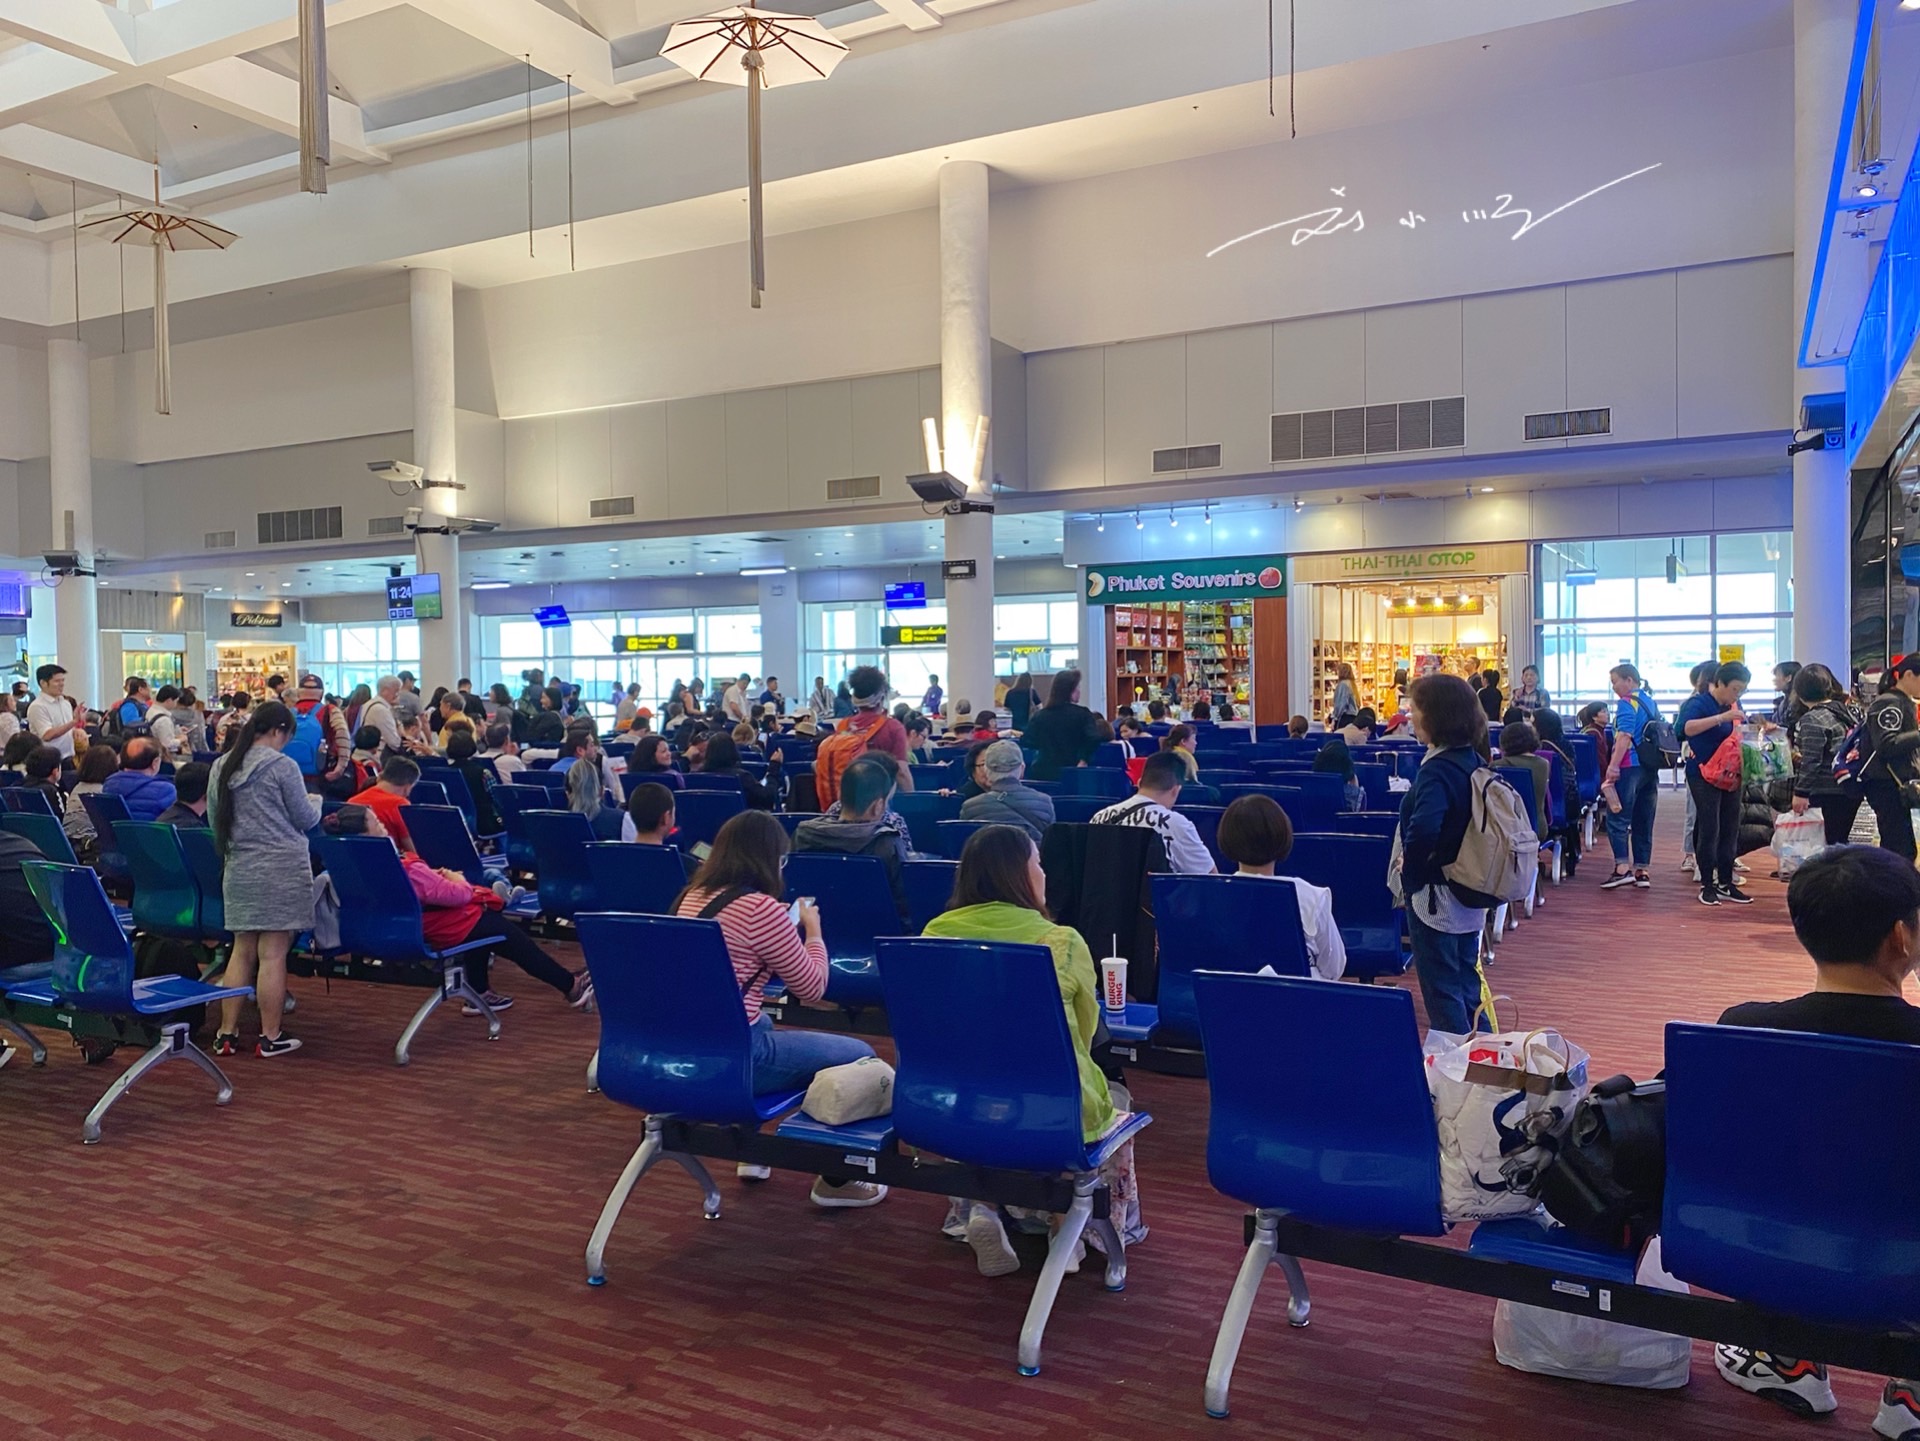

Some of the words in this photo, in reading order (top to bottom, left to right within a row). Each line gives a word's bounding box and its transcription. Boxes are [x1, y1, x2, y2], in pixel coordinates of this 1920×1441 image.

[1341, 554, 1423, 570] THAI-THAI
[1428, 551, 1476, 566] OTOP
[1107, 574, 1165, 593] Phuket
[1171, 570, 1257, 589] Souvenirs
[389, 586, 412, 600] 11:24
[667, 635, 678, 649] 8
[1108, 970, 1116, 1005] BURGER
[1460, 1211, 1493, 1219] KING
